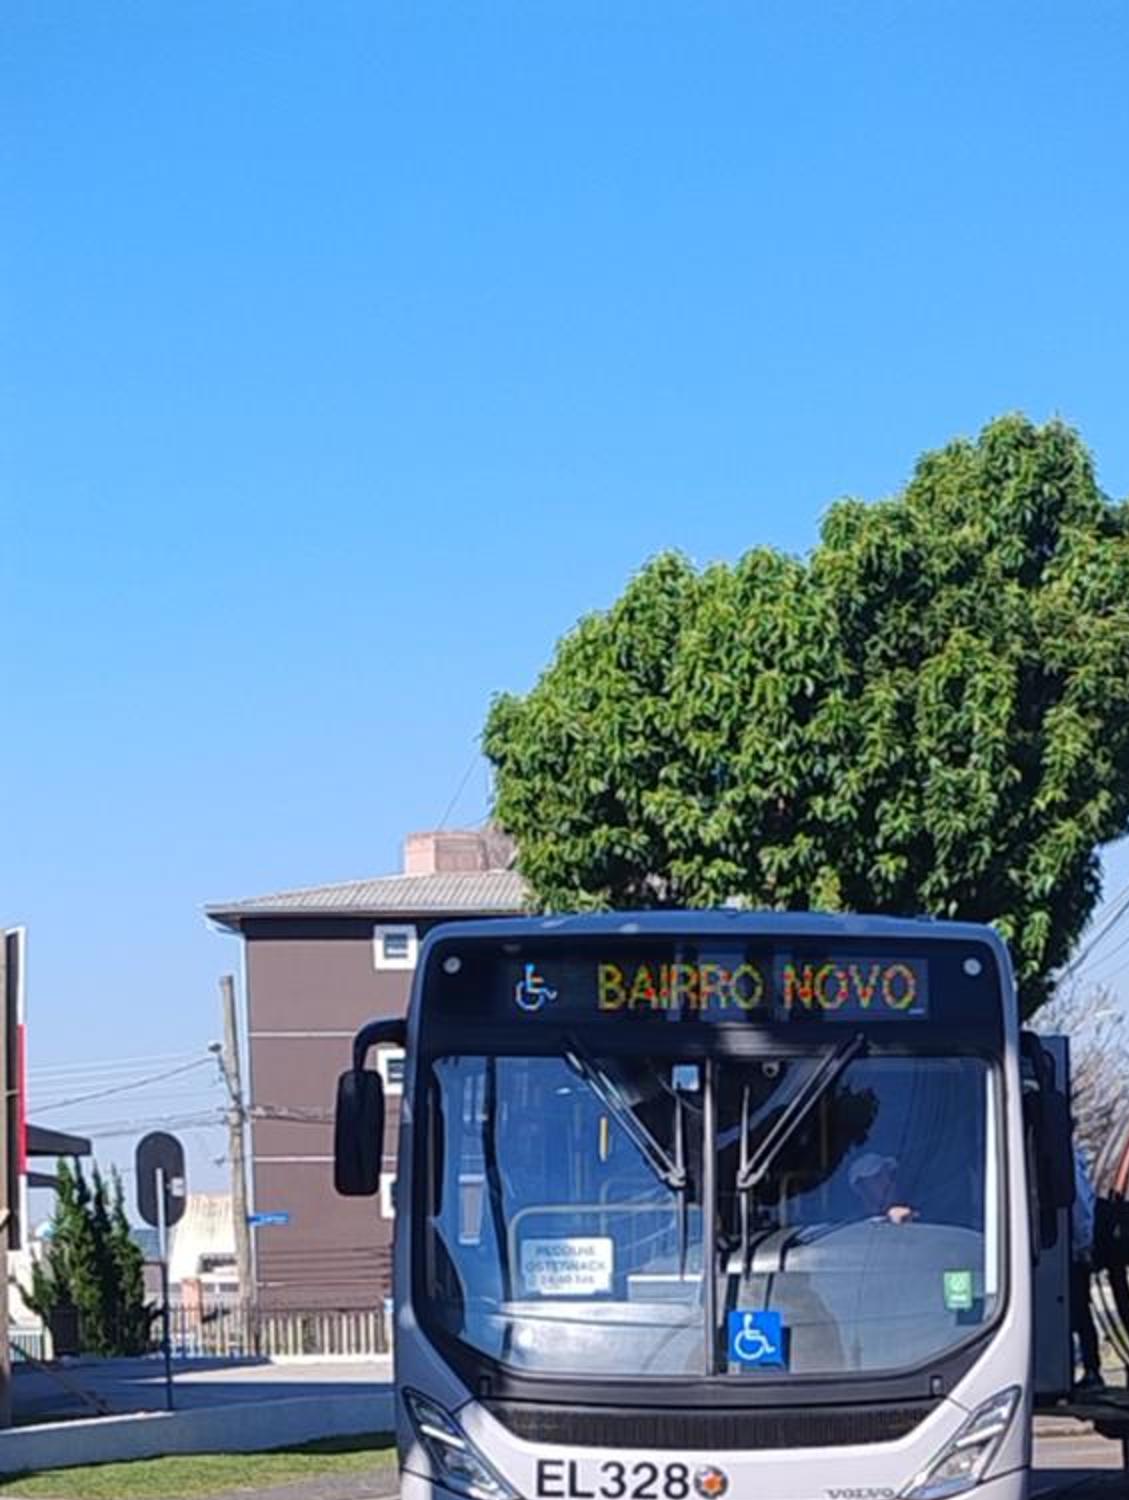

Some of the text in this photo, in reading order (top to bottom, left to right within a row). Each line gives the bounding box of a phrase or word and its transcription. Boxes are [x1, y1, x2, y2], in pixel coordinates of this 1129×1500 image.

[597, 963, 916, 1010] BAIRRO NOVO
[536, 1459, 690, 1500] EL328
[823, 1487, 895, 1500] VOLVO
